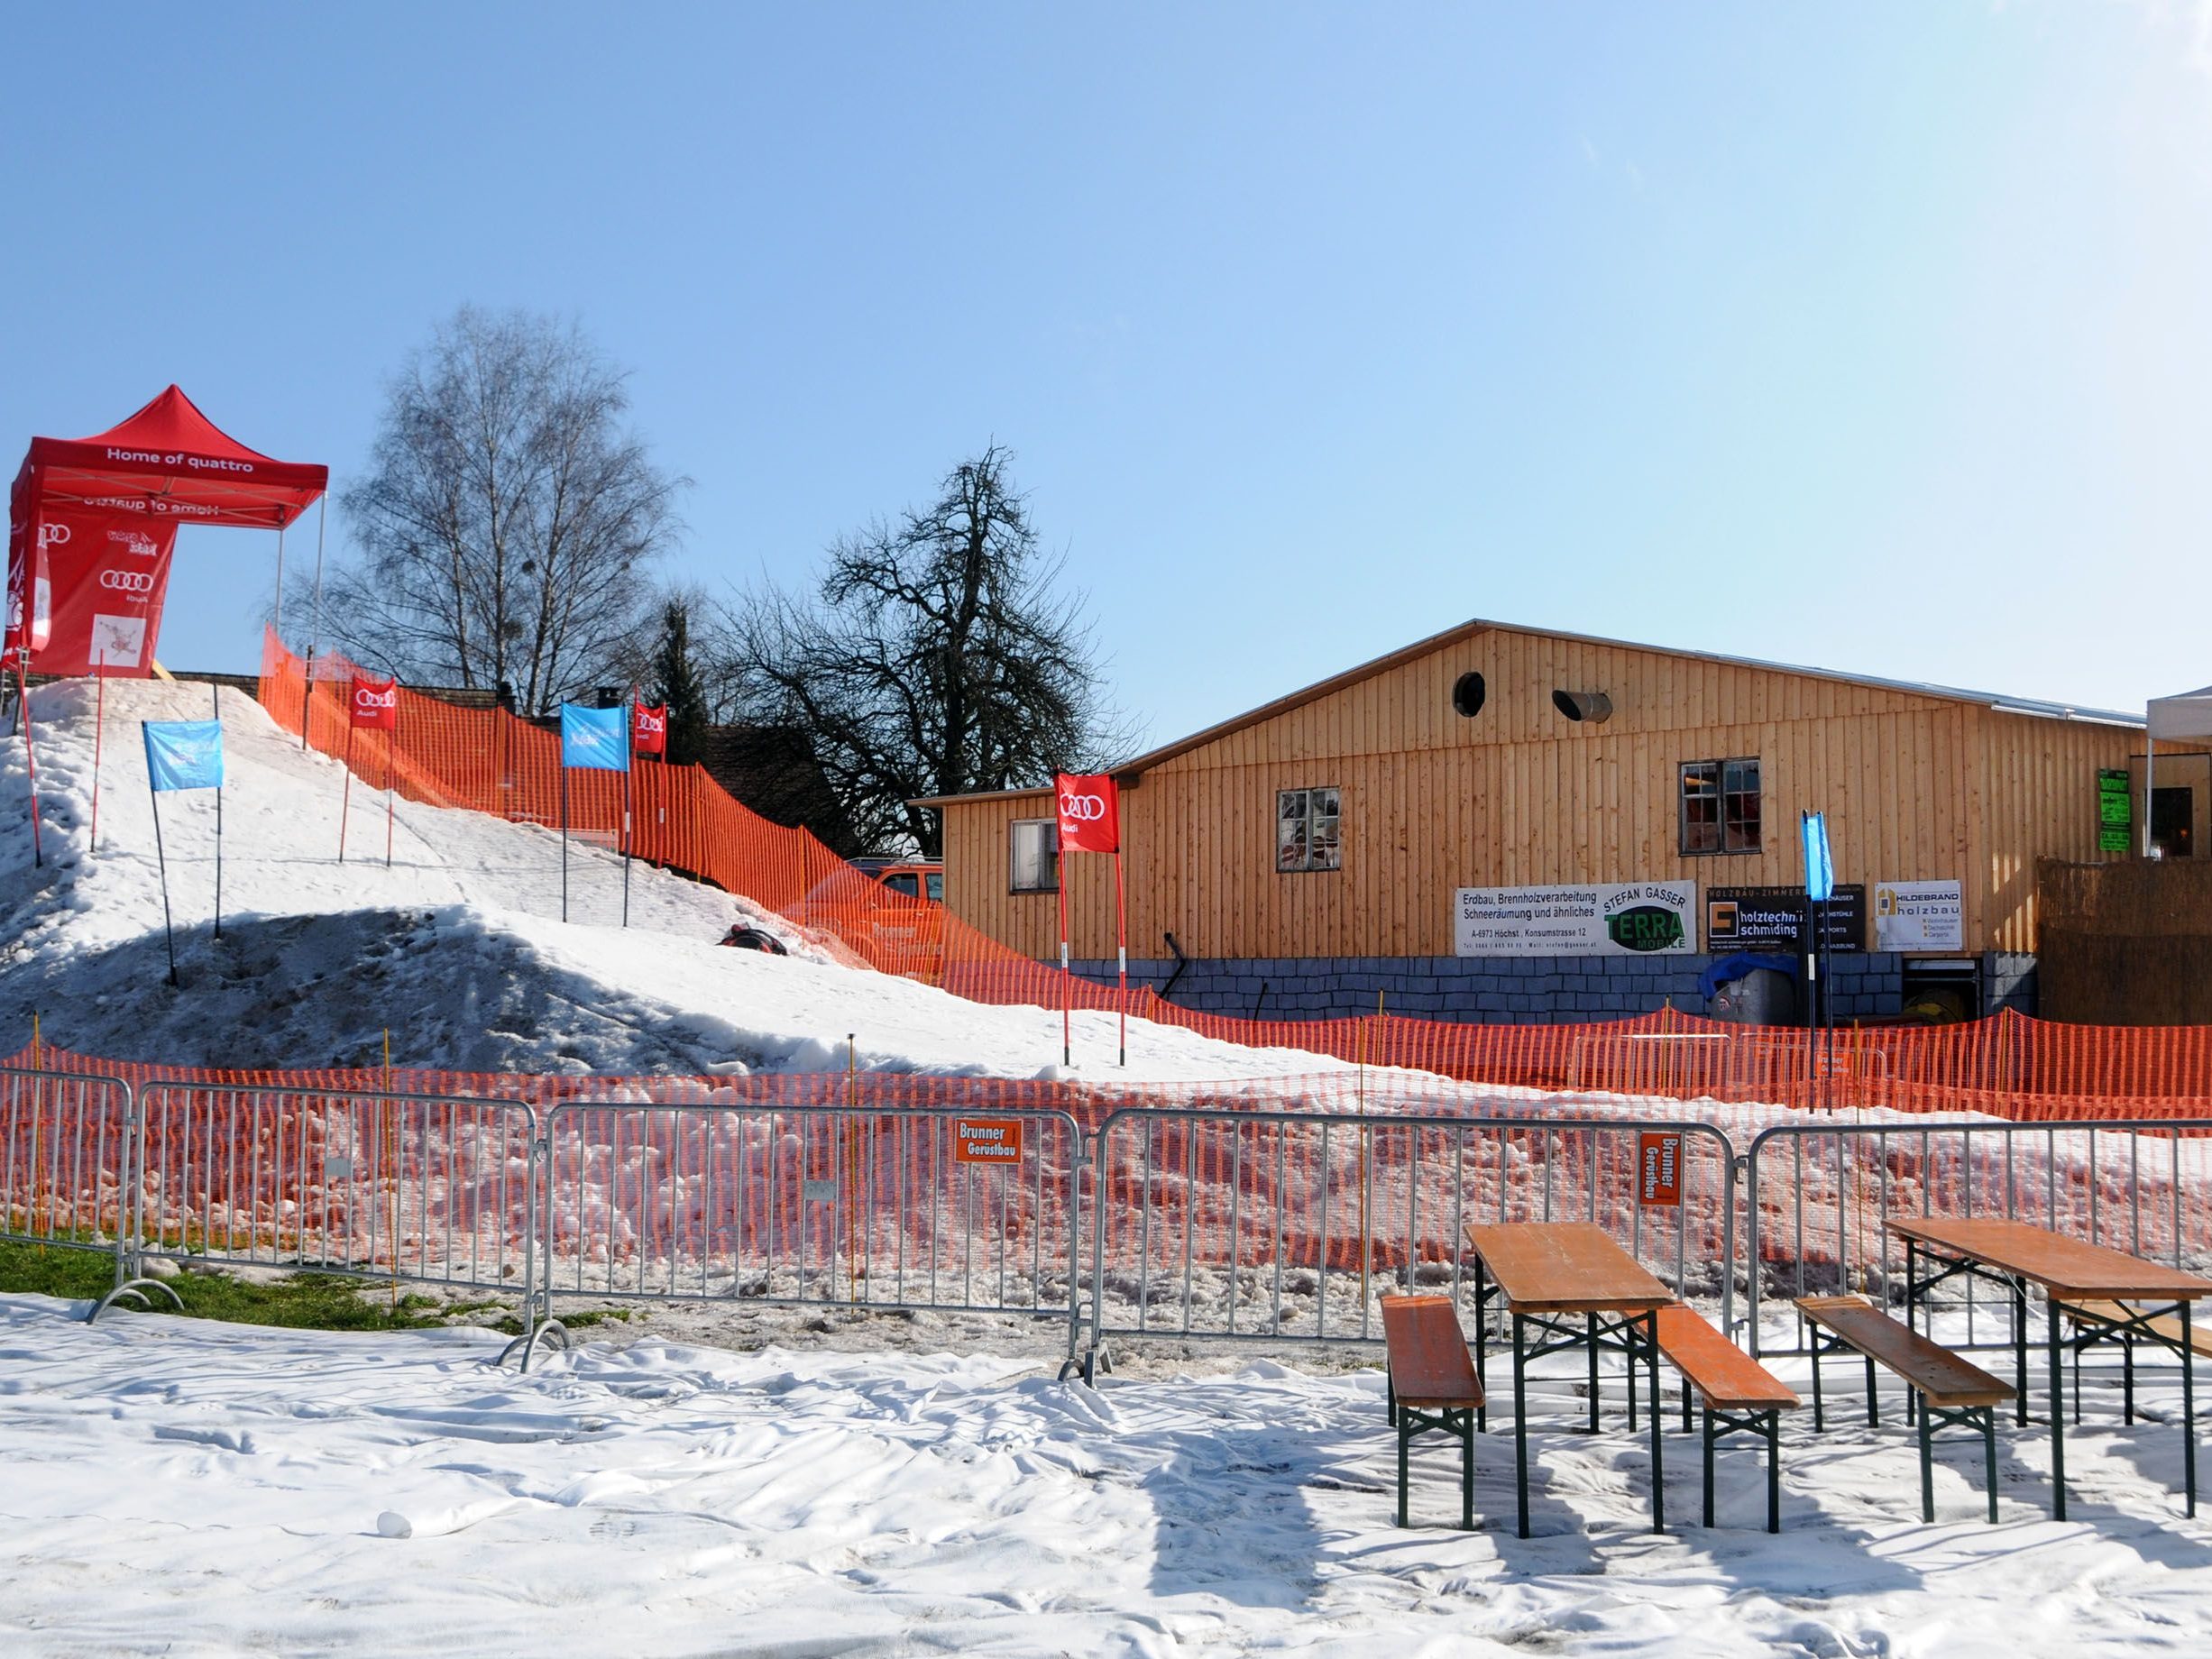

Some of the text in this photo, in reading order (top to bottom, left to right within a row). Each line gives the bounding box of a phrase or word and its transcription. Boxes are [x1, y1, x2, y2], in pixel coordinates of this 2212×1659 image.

[107, 447, 254, 472] Home of quattro
[1061, 822, 1078, 833] Audi
[1498, 891, 1597, 905] Brennholzverarbeitung
[1603, 886, 1686, 912] STEFAN GASSER
[1896, 894, 1959, 902] HILDEBRAND
[1464, 905, 1595, 921] Schneeräumung und ähnliches
[1897, 905, 1960, 915] holzbau
[1525, 928, 1576, 938] Konsumstrasse
[1578, 927, 1587, 937] 12
[1603, 912, 1685, 940] TERRA
[1740, 923, 1798, 939] schmiding
[1638, 938, 1685, 949] MOBILE
[959, 1122, 1005, 1140] Brunner
[968, 1141, 1016, 1157] Gerüstbau
[1662, 1138, 1678, 1188] Brunner
[1645, 1146, 1659, 1199] Gerüstbau
